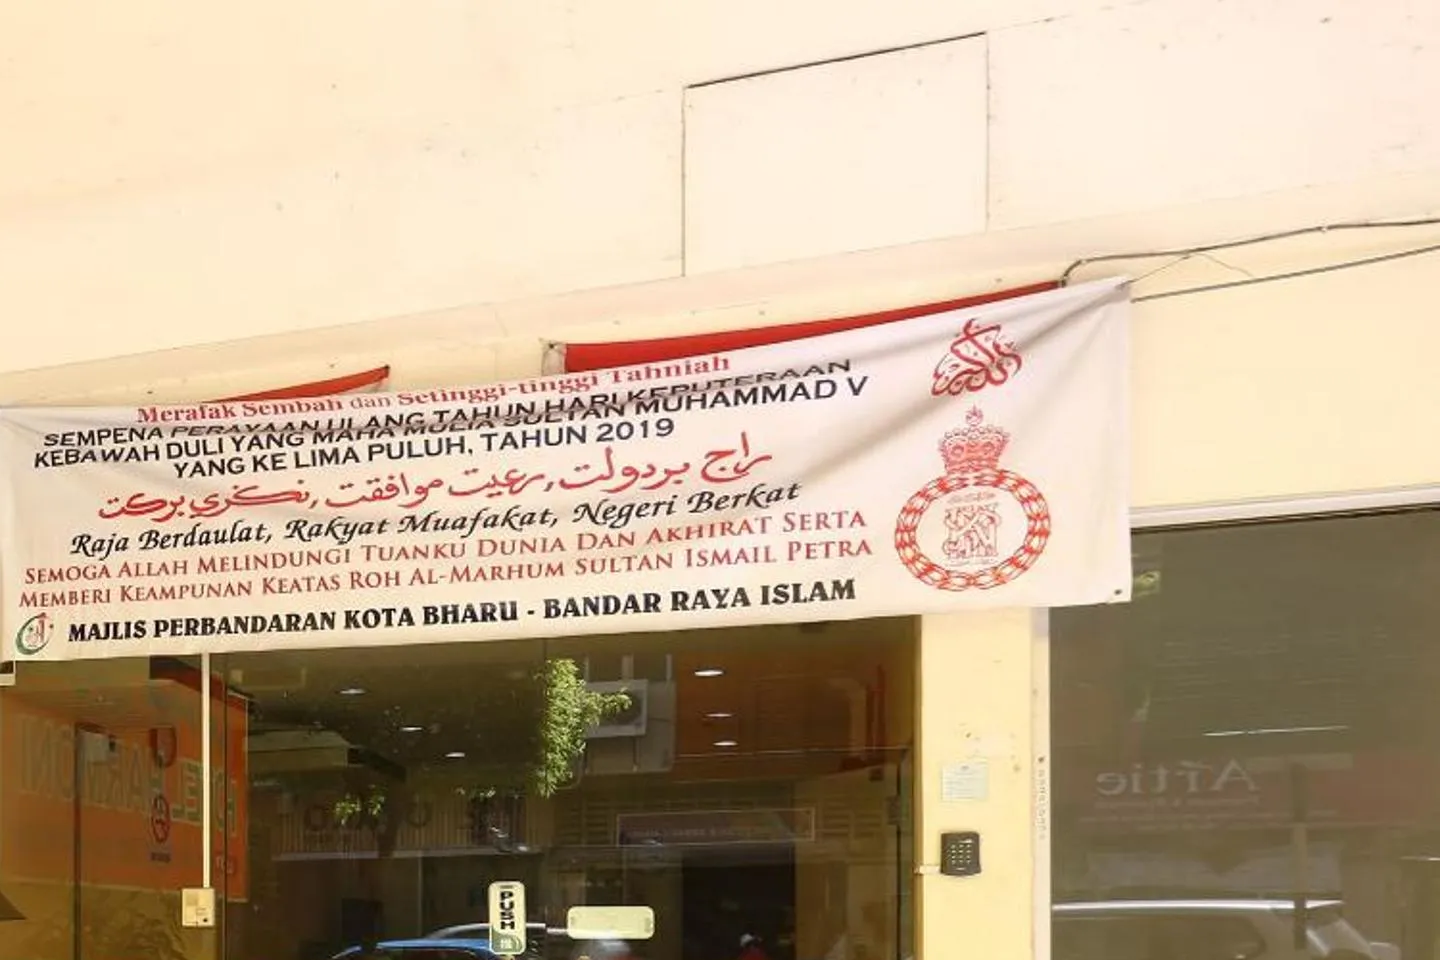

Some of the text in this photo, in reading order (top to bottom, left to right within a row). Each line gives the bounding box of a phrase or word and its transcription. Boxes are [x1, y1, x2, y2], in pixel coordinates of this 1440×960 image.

[34, 375, 869, 469] KEBAWAH DULI YANG MAHA MULIA SULTAN MUHAMMAD V
[43, 426, 163, 448] SEMPENA
[170, 419, 320, 438] PERAYAAN
[434, 401, 535, 424] TAHUN
[544, 389, 618, 415] HARI
[626, 359, 851, 402] KEPUTERAAN
[137, 354, 731, 424] Merafak Sembah dan Setinggi-tinggi Tahniah
[174, 417, 675, 479] YANG KE LIMA PULUH, TAHUN 2019
[24, 509, 868, 585] SEMOGA ALLAH MELINDUNGI TUANKU DUNIA DAN AKHIRAT SERTA
[70, 482, 803, 561] Raja Berdaulat, Rakyat Muafakat, Negeri Berkat
[19, 588, 110, 608] MEMBERI
[120, 580, 253, 604] KEAMPUNAN
[261, 575, 341, 596] KEATAS
[350, 570, 401, 590] ROH
[575, 552, 674, 576] SULTAN
[686, 545, 777, 568] ISMAIL
[787, 538, 874, 563] PETRA
[68, 618, 147, 643] MAJLIS
[153, 610, 337, 639] PERBANDARAN
[344, 606, 415, 630] KOTA
[422, 600, 519, 626] BHARU
[543, 592, 662, 620] BANDAR
[671, 587, 752, 611] RAYA
[760, 578, 857, 606] ISLAM
[499, 890, 516, 931] PUSH
